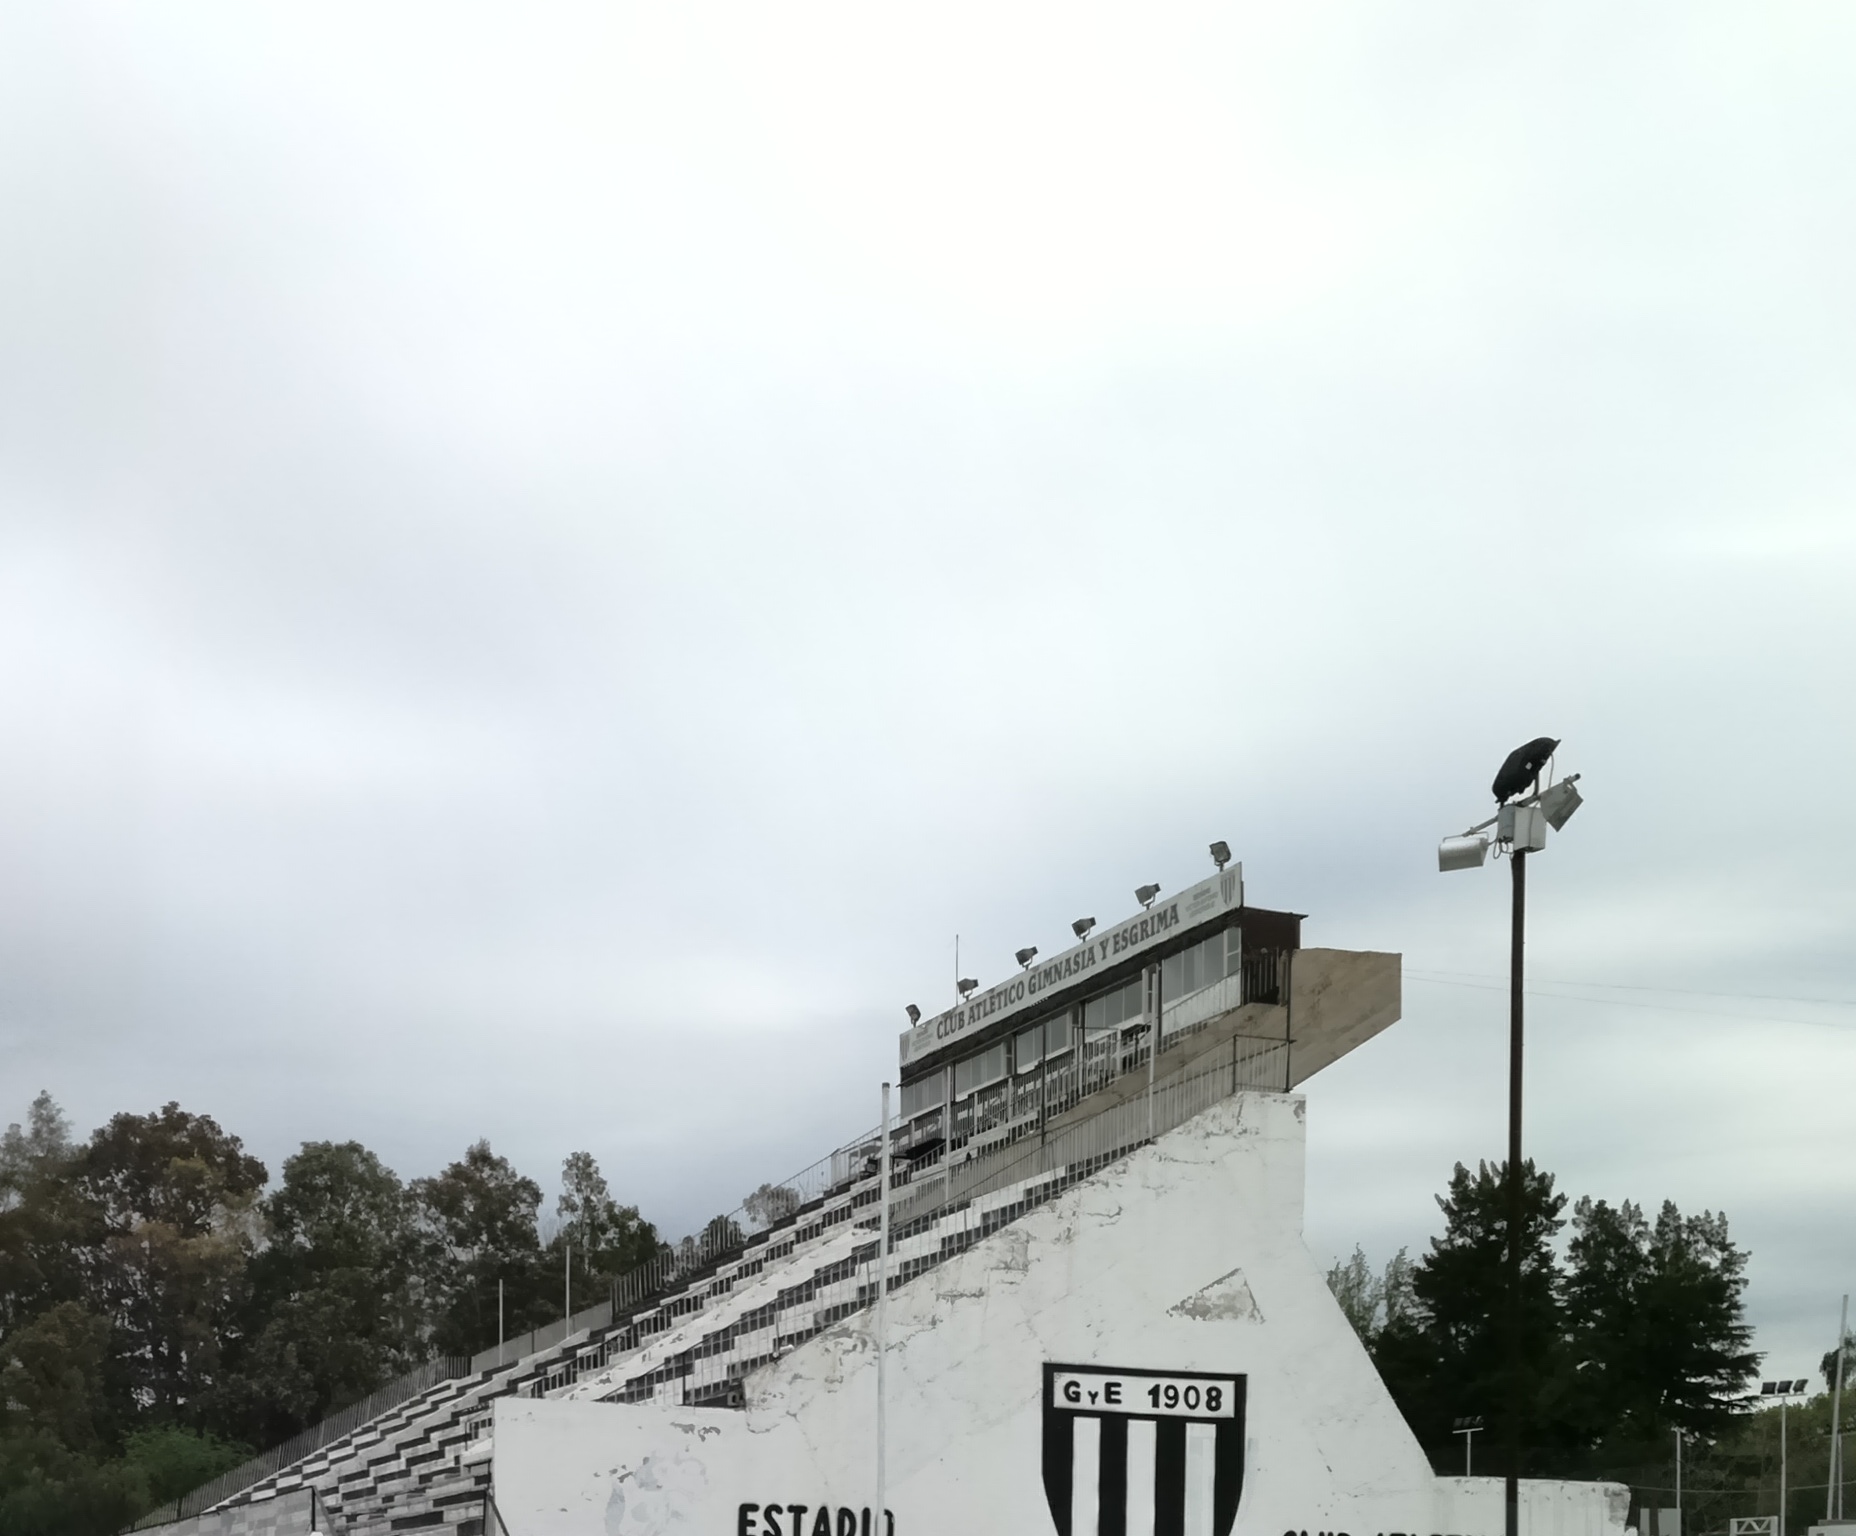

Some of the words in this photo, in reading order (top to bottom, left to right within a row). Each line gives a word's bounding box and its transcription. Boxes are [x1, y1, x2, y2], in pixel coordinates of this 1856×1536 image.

[935, 1007, 966, 1040] CLUB
[967, 981, 1025, 1024] ATLÉTICO
[1027, 946, 1096, 996] GIMNASIA
[1099, 938, 1111, 961] Y
[1113, 903, 1180, 955] ESGRIMA
[1147, 1384, 1224, 1412] 1908
